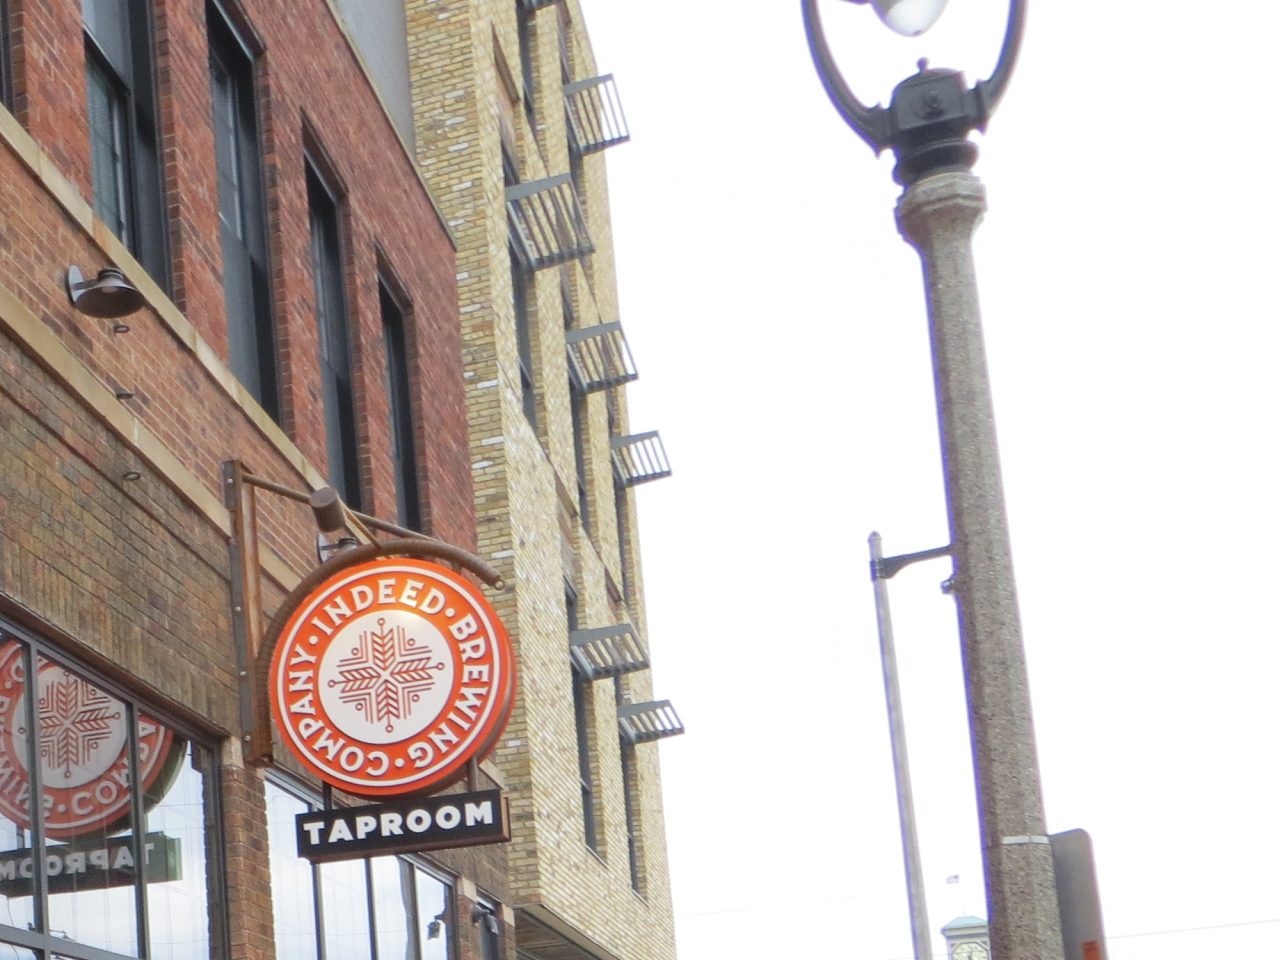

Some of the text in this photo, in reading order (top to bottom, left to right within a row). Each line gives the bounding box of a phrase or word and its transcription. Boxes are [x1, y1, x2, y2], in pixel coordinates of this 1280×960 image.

[288, 578, 490, 776] INDEED BREWING COMPANY
[304, 801, 494, 845] TAPROOM
